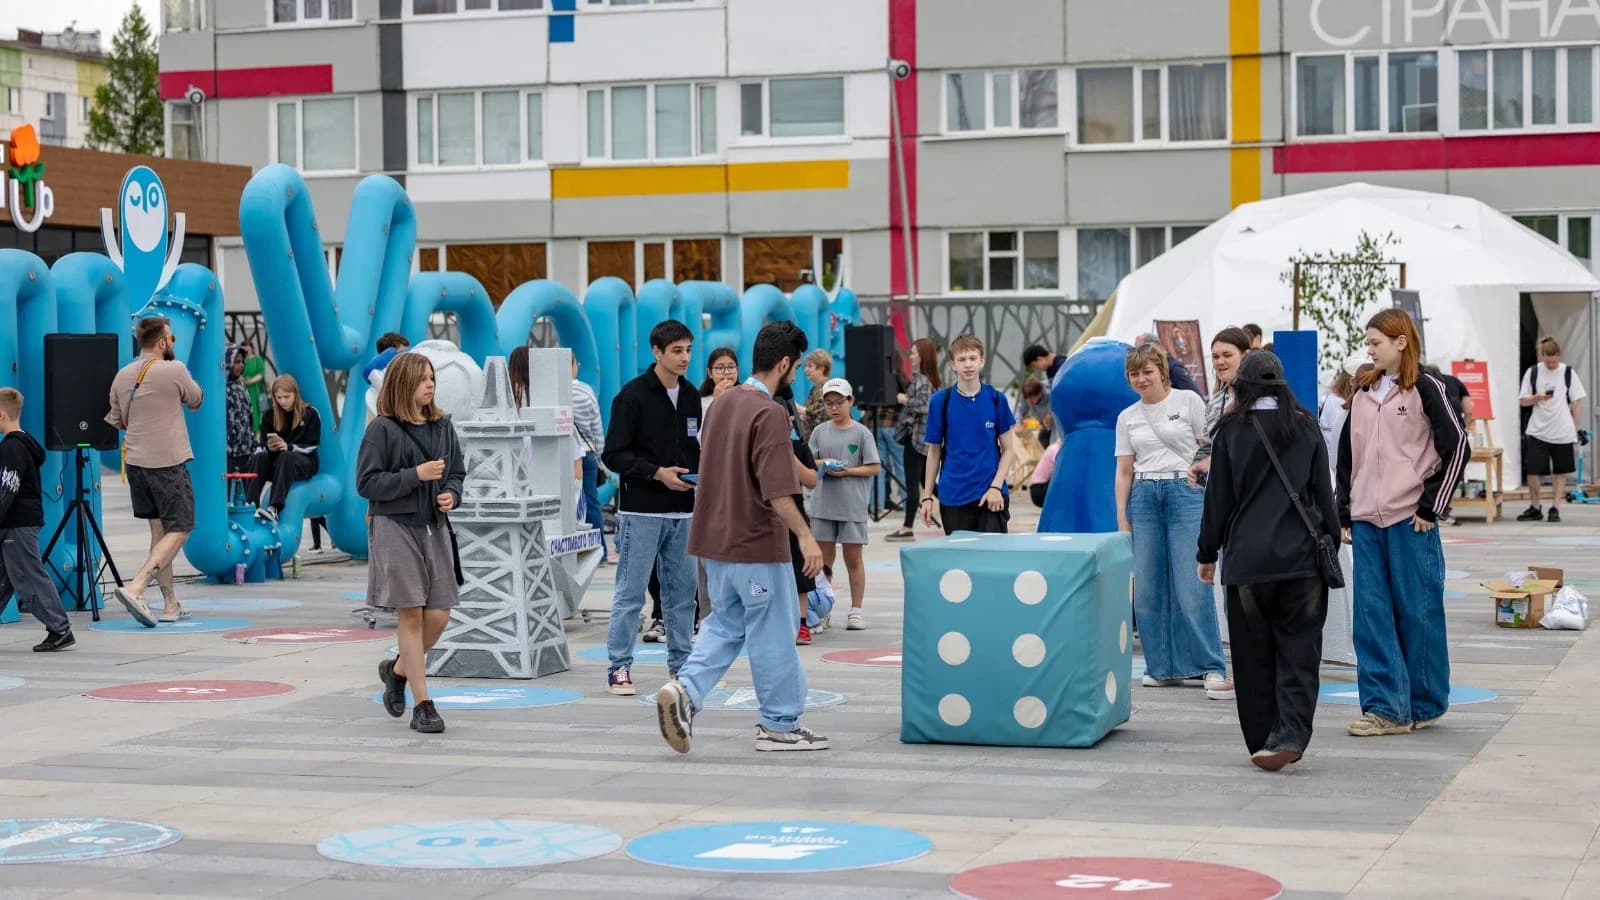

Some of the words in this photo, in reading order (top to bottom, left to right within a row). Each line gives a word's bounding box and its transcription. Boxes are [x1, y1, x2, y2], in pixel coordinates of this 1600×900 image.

[1310, 0, 1600, 46] СТРАНА
[415, 836, 525, 848] 40
[1055, 873, 1173, 892] 42
